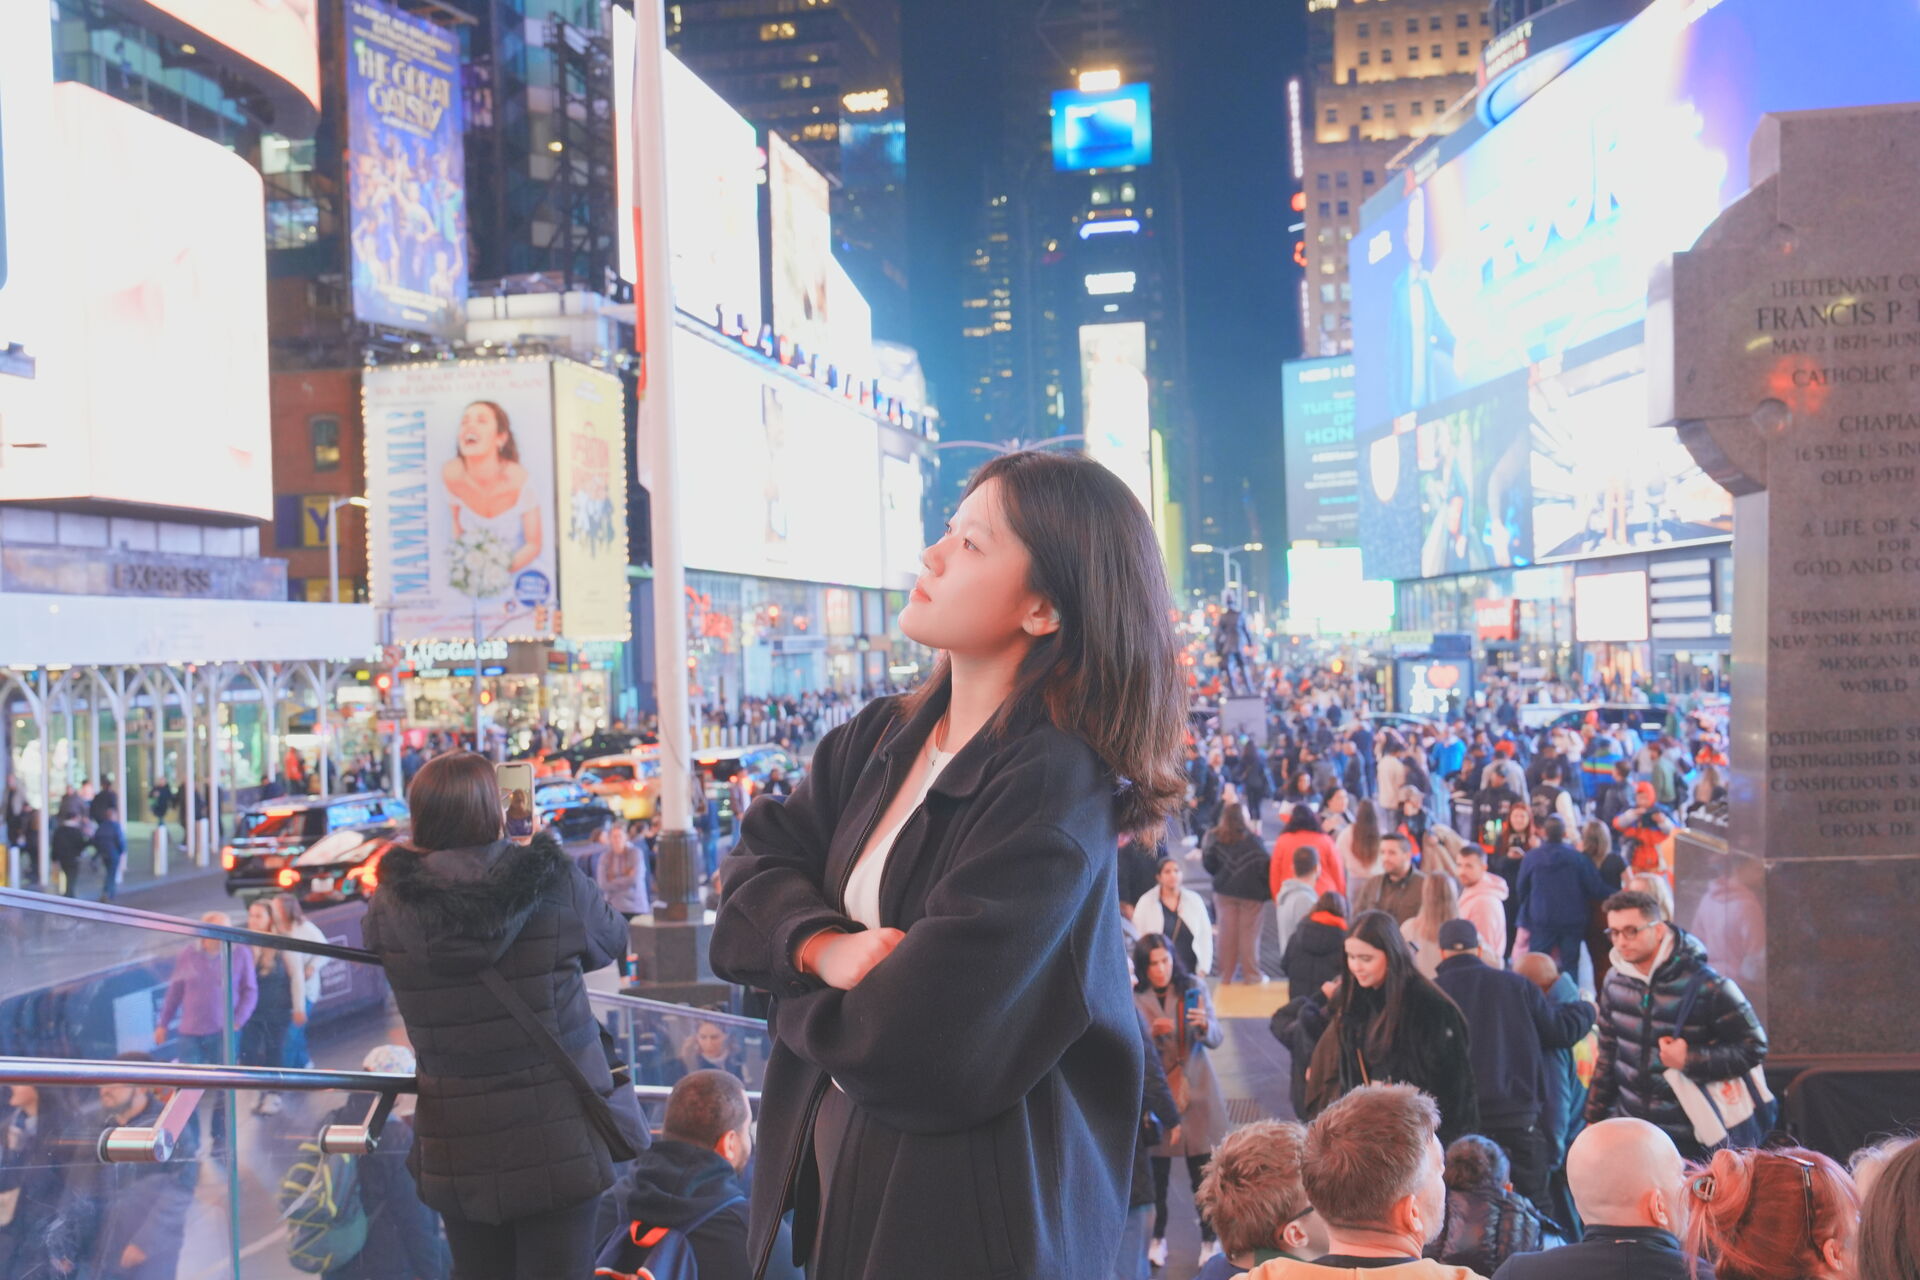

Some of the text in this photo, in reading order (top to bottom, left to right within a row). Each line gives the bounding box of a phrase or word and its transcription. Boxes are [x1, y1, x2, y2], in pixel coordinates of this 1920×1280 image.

[391, 60, 450, 109] GREAT
[368, 80, 442, 131] GATSBY
[1771, 274, 1889, 298] LIEUTENANT
[1757, 301, 1875, 331] FRANCIS
[1772, 335, 1810, 353] MAY
[1792, 364, 1896, 387] CATHOLIC
[1839, 413, 1920, 433] CHAPLA
[386, 410, 428, 475] MIA!
[1821, 467, 1863, 485] OLD
[306, 506, 330, 543] Y
[1823, 518, 1865, 537] LIFE
[1872, 518, 1899, 535] OF
[388, 484, 431, 595] MAMMA
[1878, 537, 1911, 553] FOR
[1793, 558, 1842, 577] GOD
[1846, 557, 1893, 575] AND
[114, 563, 211, 592] EXPRESS
[1790, 608, 1861, 625] SPANISH
[405, 641, 508, 661] LUGGAGE
[1769, 635, 1808, 650] NEW
[1814, 632, 1861, 648] YORK
[1819, 654, 1901, 671] MEXICAN
[1840, 677, 1909, 694] WORLD
[1769, 727, 1899, 747] DISTINGUISHED
[1769, 749, 1900, 769] DISTINGUISHED
[1770, 773, 1899, 793] CONSPICUOUS
[1818, 797, 1882, 815] LEGION
[1819, 820, 1915, 838] CROIX DE
